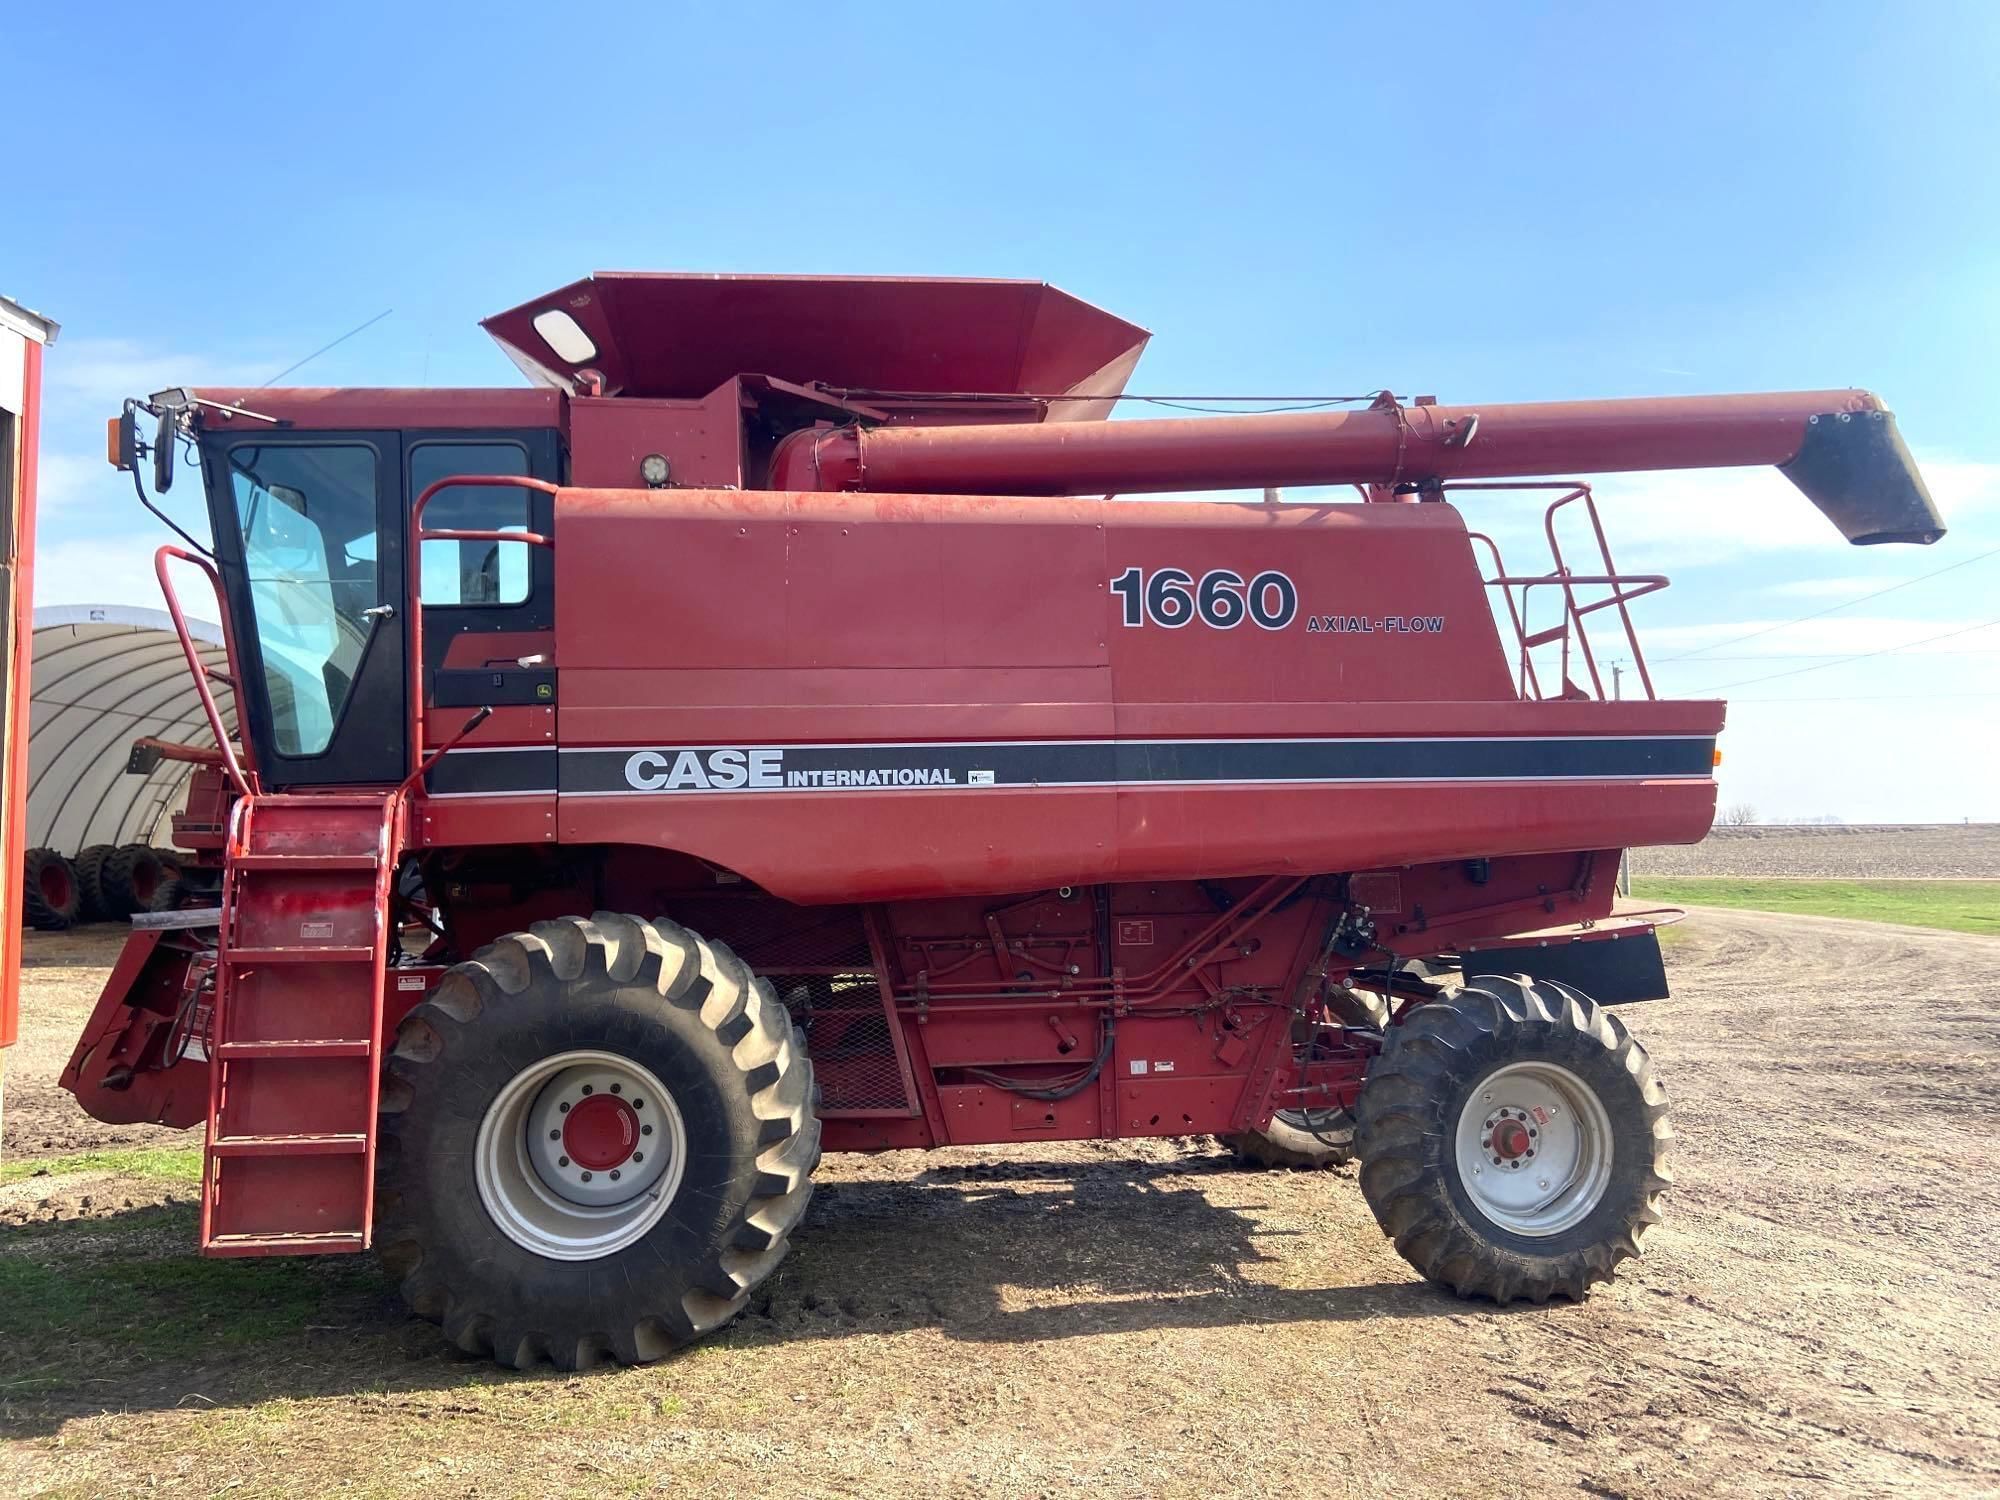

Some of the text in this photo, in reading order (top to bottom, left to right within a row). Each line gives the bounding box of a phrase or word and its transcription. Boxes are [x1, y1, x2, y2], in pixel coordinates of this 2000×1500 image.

[1110, 567, 1297, 630] 1660
[1306, 615, 1445, 633] AXIAL-FLOW
[624, 750, 956, 790] CASE INTERNATIONAL
